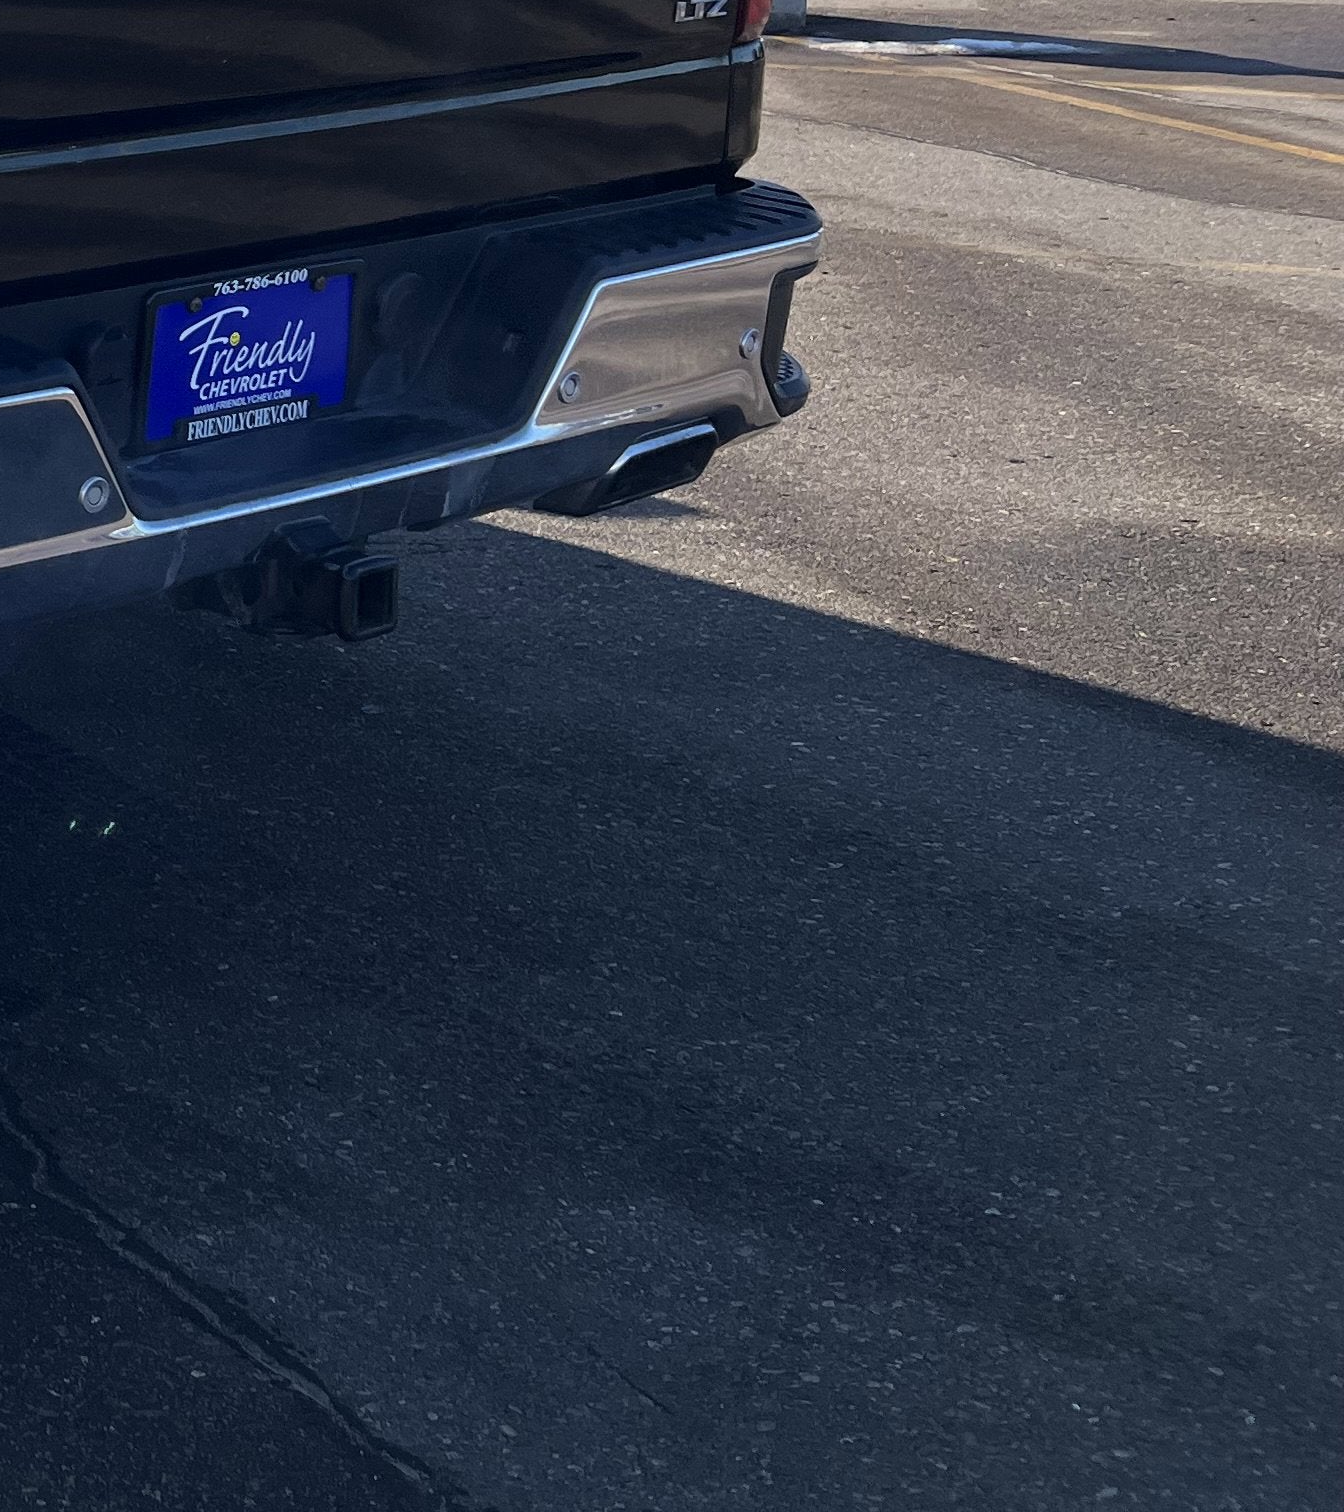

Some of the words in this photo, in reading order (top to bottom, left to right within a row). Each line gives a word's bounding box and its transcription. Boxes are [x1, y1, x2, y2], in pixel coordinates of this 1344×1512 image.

[214, 268, 309, 297] 763-786-6100
[179, 305, 316, 390] Friendly
[199, 368, 289, 401] CHEVROLET
[193, 388, 293, 416] WWW.FRIENDLYCHEV.COM
[187, 399, 310, 441] FRIENDLYCHEV.COM
